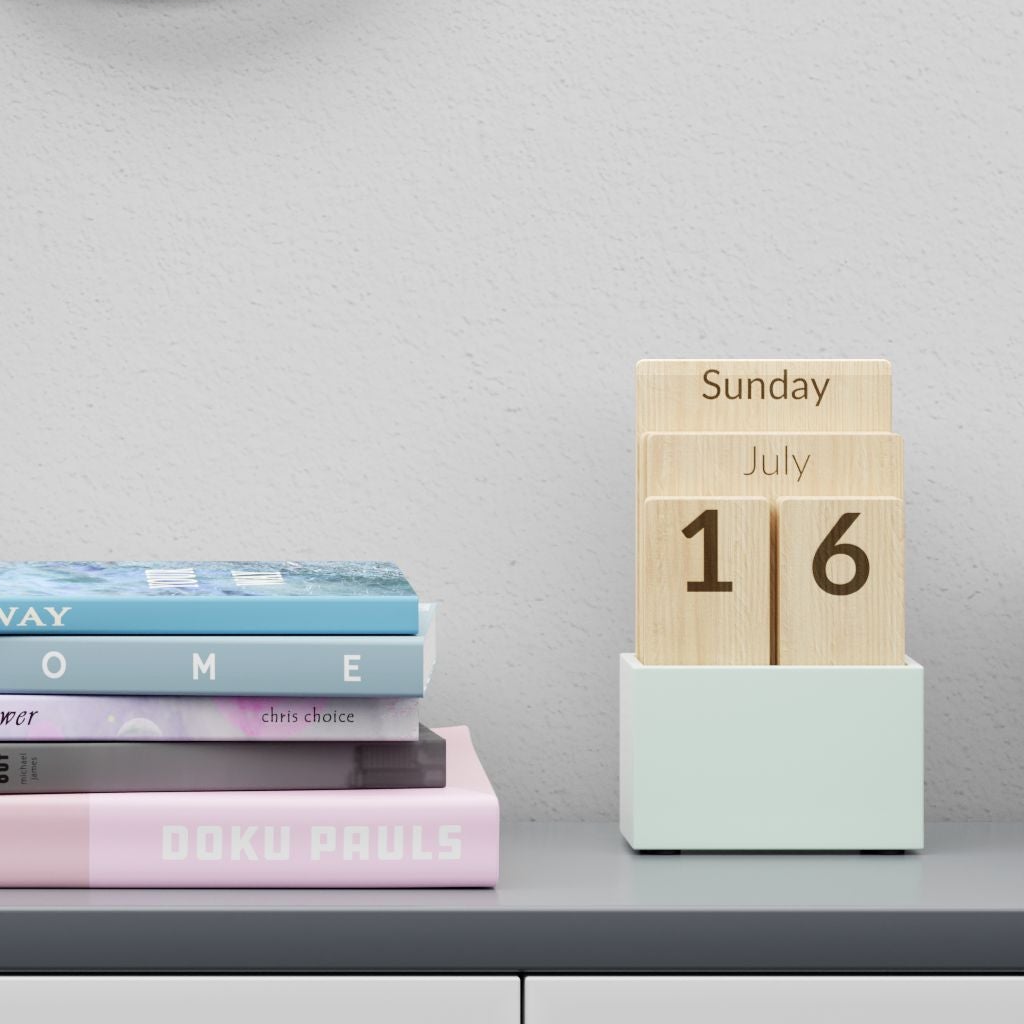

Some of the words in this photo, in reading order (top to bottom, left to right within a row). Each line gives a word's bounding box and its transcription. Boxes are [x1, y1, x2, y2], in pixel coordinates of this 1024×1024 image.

[702, 369, 830, 406] Sunday
[743, 445, 811, 482] July
[261, 707, 298, 723] chris
[304, 707, 355, 723] choice
[19, 752, 28, 785] michael
[161, 824, 292, 861] DOKU
[310, 824, 463, 861] PAULS
